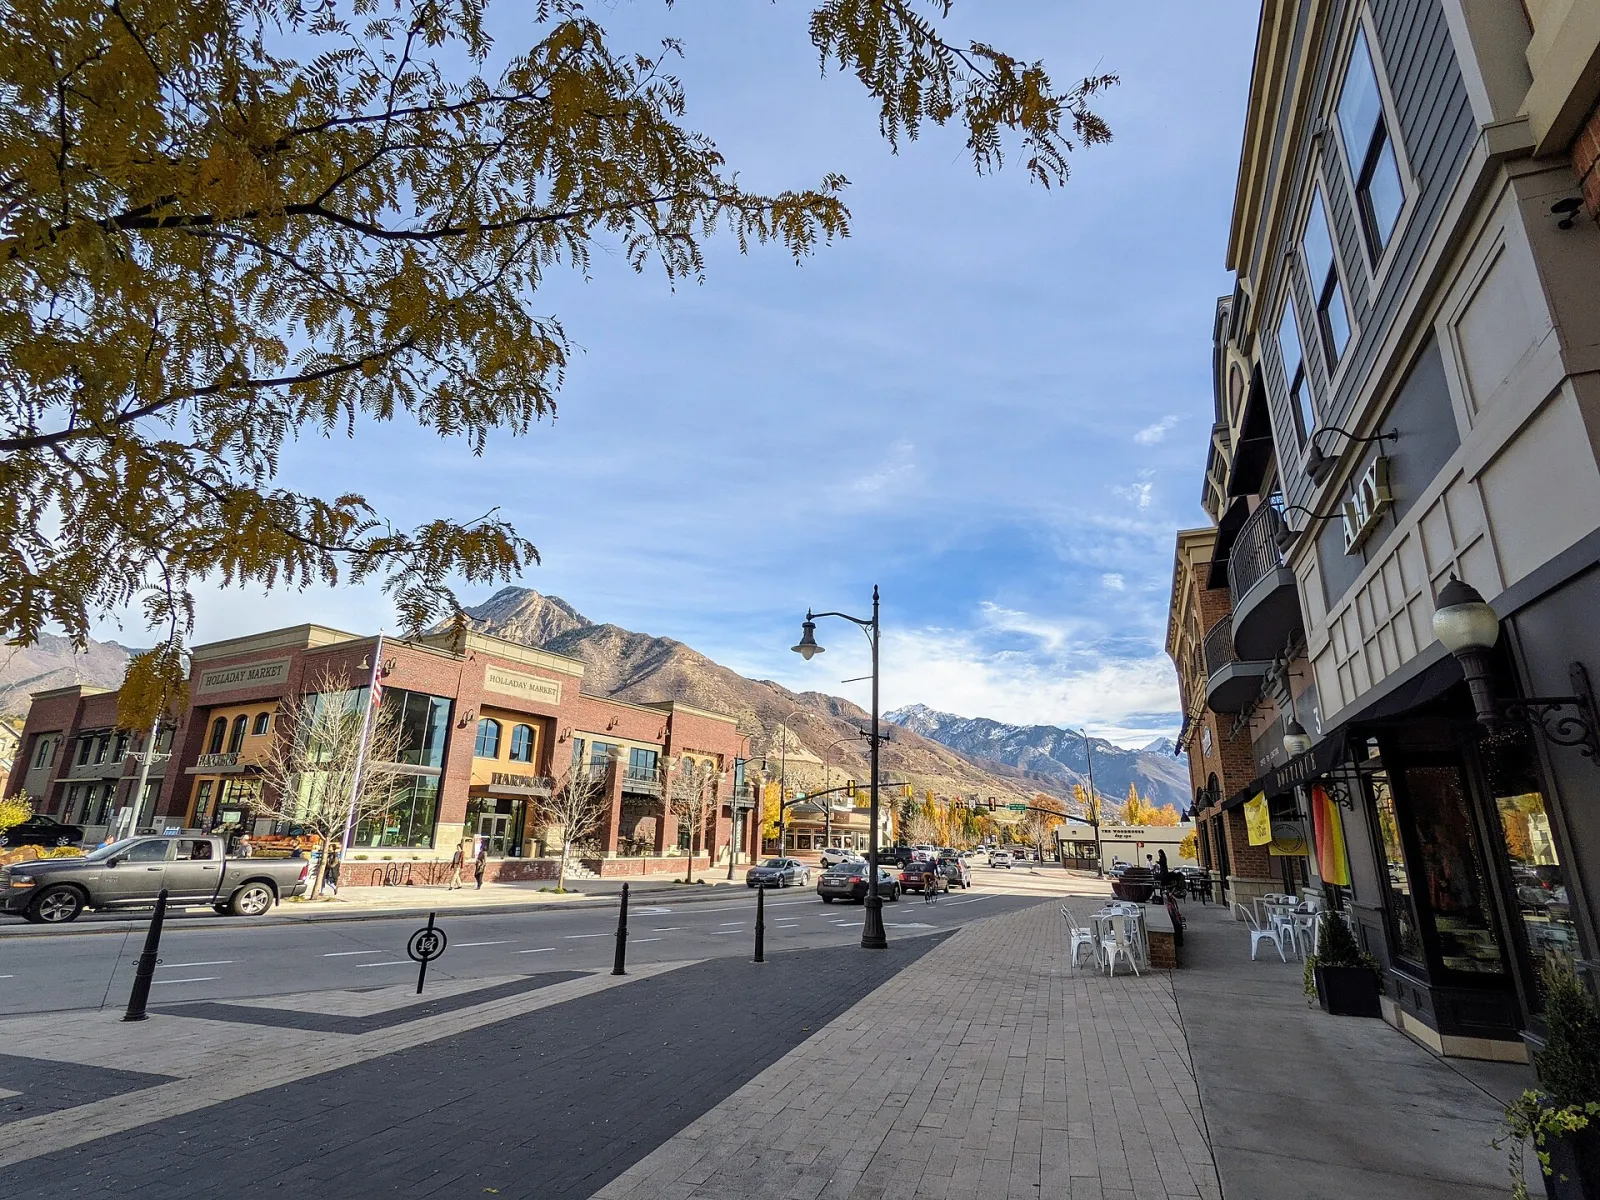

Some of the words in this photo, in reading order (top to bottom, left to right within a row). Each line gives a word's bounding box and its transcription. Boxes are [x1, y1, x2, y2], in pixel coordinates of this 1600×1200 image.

[1341, 455, 1383, 556] AMY
[205, 671, 245, 687] HOLLADAY
[247, 664, 284, 681] MARKET
[489, 674, 528, 689] HOLLADAY
[528, 683, 557, 696] MARKET
[1312, 706, 1321, 735] 3
